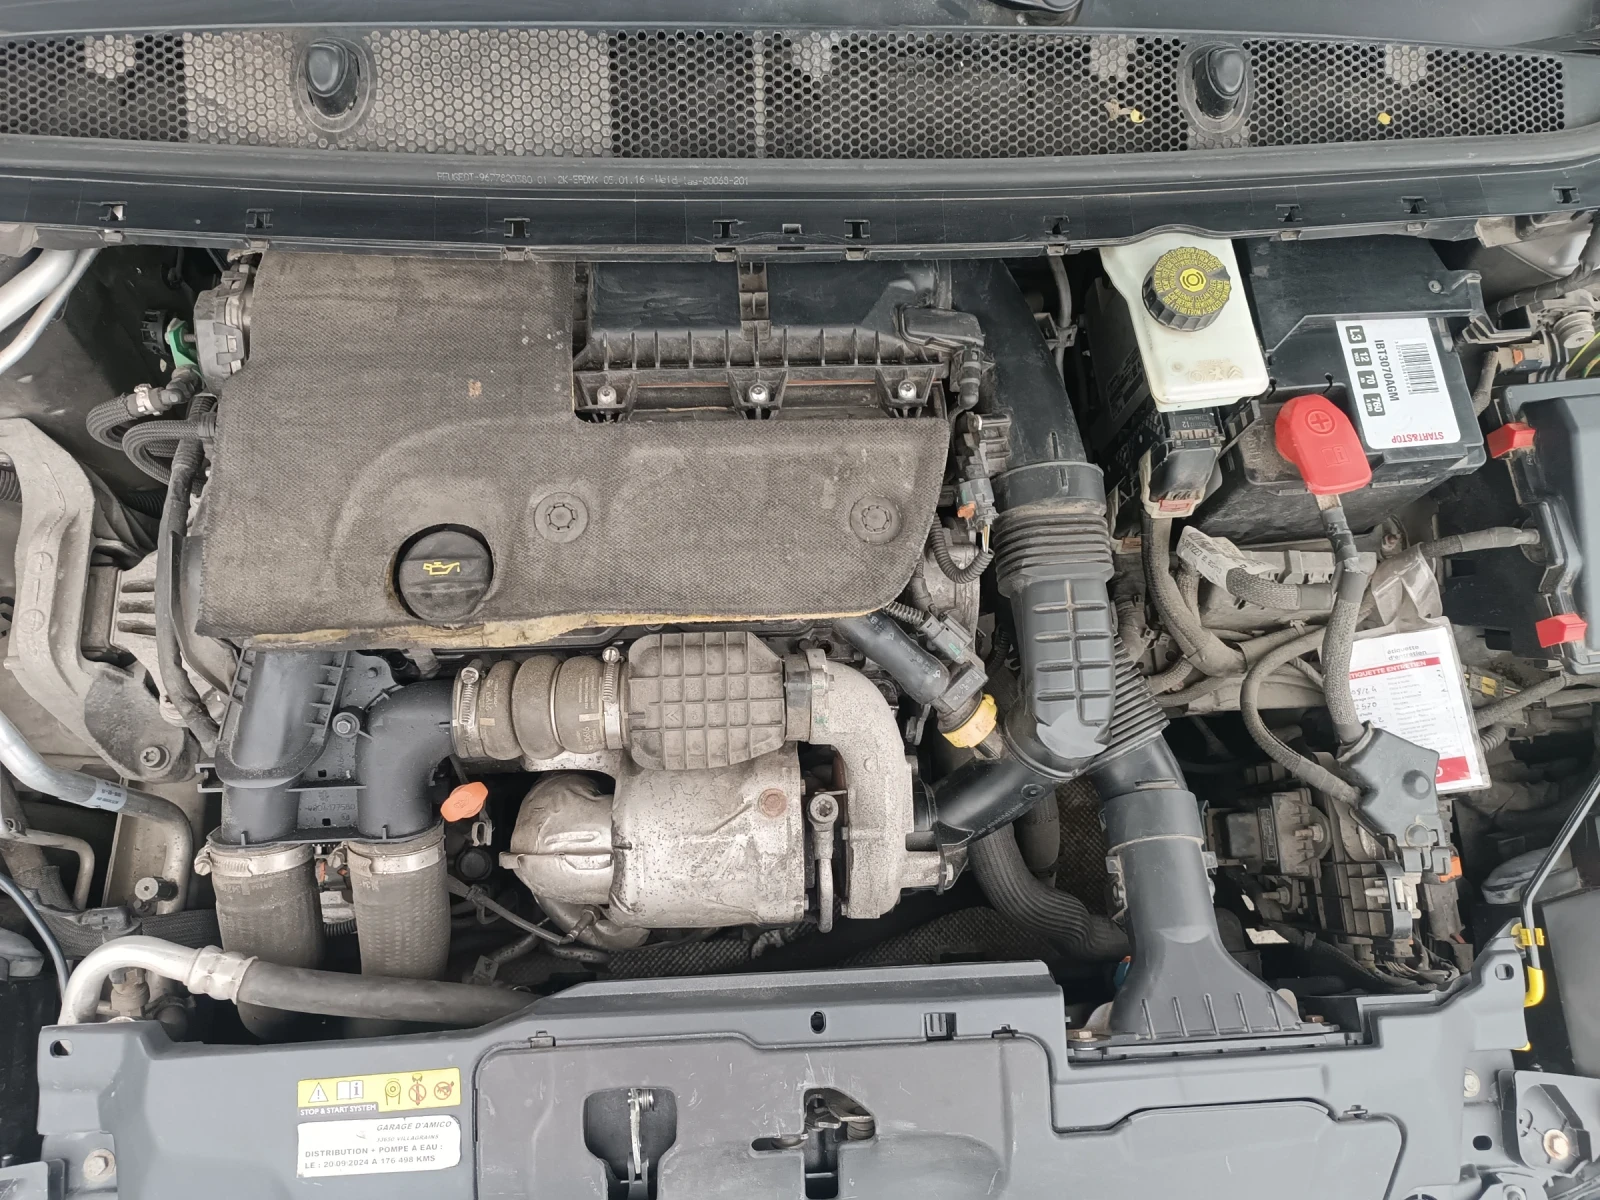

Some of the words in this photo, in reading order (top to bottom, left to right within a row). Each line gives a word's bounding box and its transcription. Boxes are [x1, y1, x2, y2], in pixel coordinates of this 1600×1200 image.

[1194, 290, 1210, 302] CLEAN
[1172, 303, 1187, 314] FLUID
[1205, 300, 1222, 313] SEALED
[1350, 328, 1362, 341] L3
[1360, 352, 1370, 362] 12
[1374, 340, 1400, 402] IBT3070AGM
[1365, 374, 1376, 384] 70
[1371, 396, 1383, 412] 760
[1392, 432, 1444, 443] START&STOP
[1387, 644, 1420, 655] étiquette
[1388, 650, 1428, 660] d'entretien
[1386, 660, 1427, 673] ENTRETIEN
[327, 1106, 348, 1114] START
[350, 1104, 376, 1112] SYSTEM
[376, 1122, 412, 1131] GARAGE
[415, 1121, 452, 1129] D'AMICO
[305, 1148, 368, 1158] DISTRIBUTION
